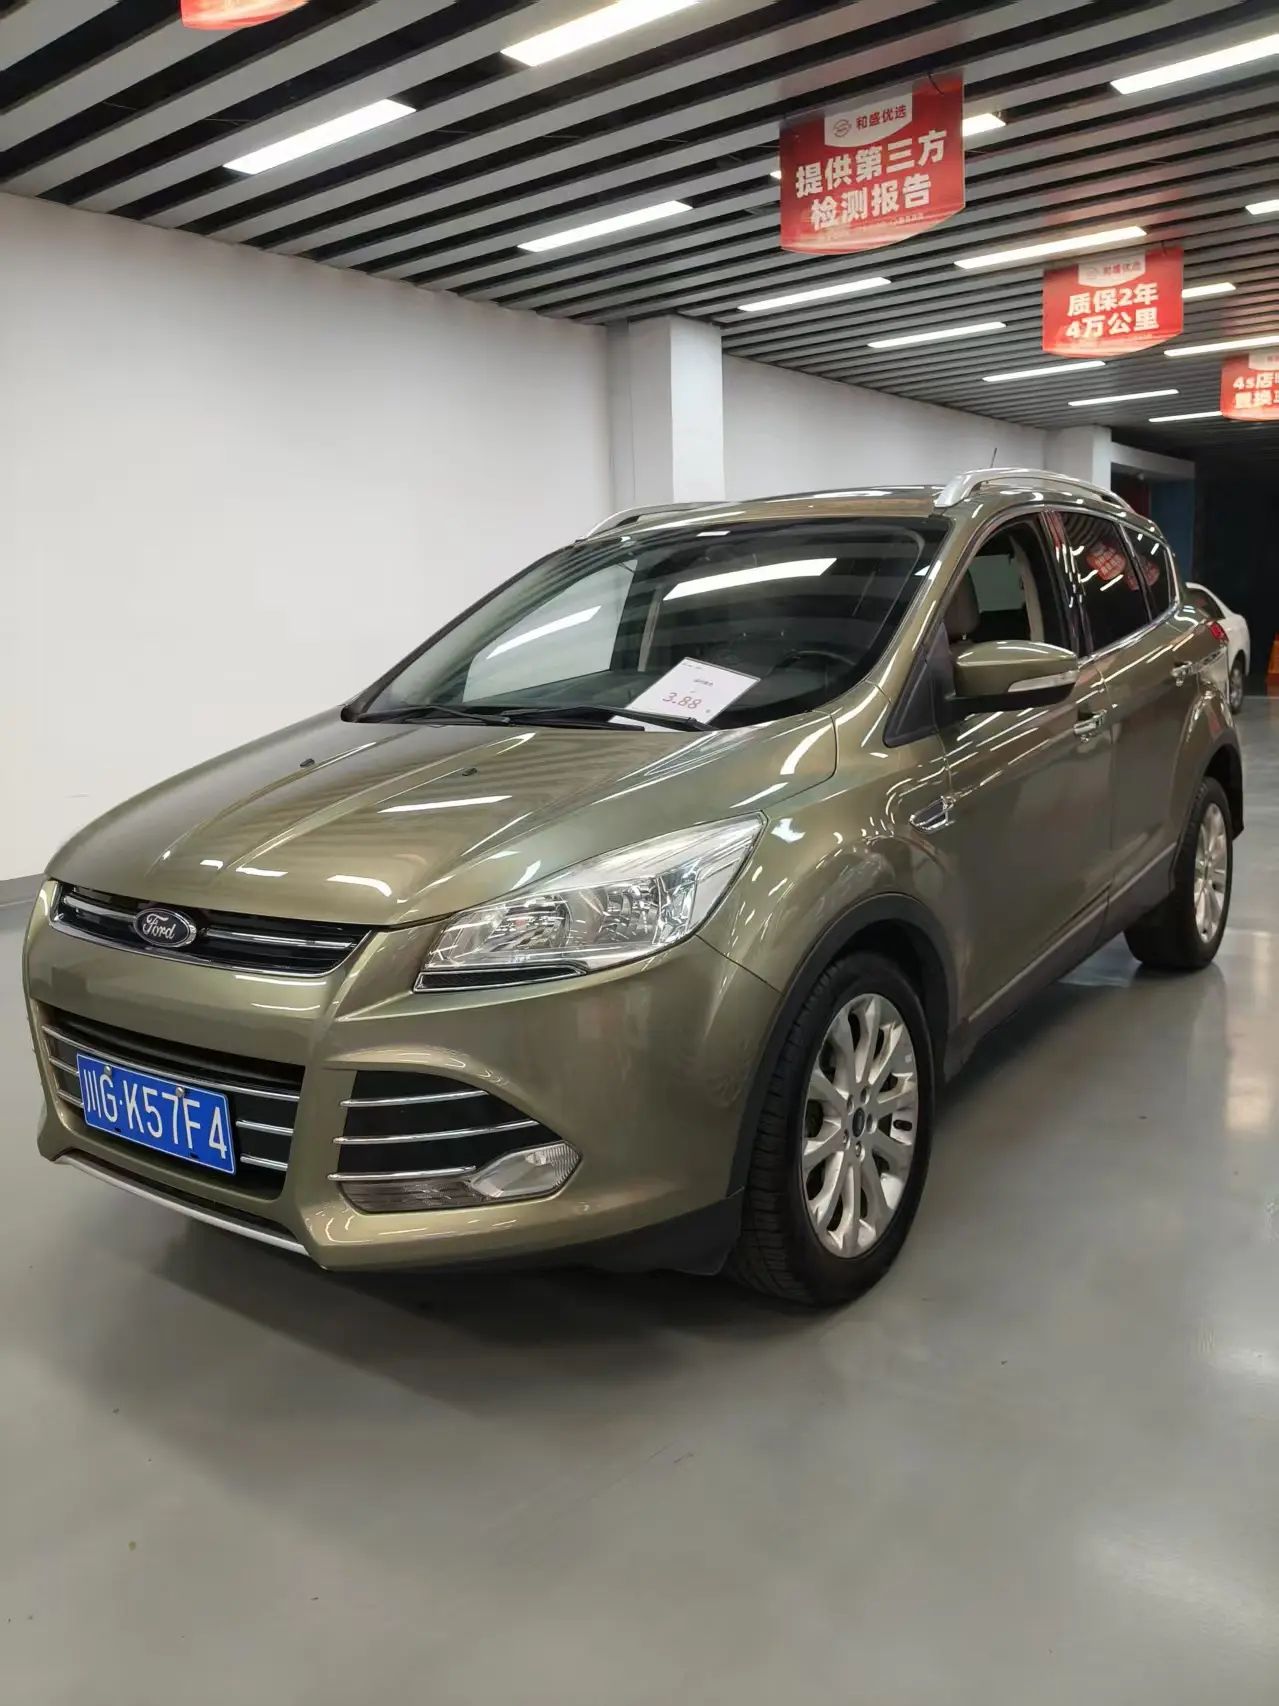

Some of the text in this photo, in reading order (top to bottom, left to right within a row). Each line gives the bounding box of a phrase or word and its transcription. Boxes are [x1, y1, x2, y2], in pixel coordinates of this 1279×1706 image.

[855, 104, 907, 130] 和盛优选
[795, 129, 948, 199] 提供第三方
[810, 173, 932, 231] 检测报告
[1067, 282, 1159, 316] 质保2年
[1066, 308, 1160, 339] 4万公里
[662, 691, 702, 710] 3.88
[142, 912, 177, 940] Ford
[82, 1067, 228, 1160] 川G·K57F4
